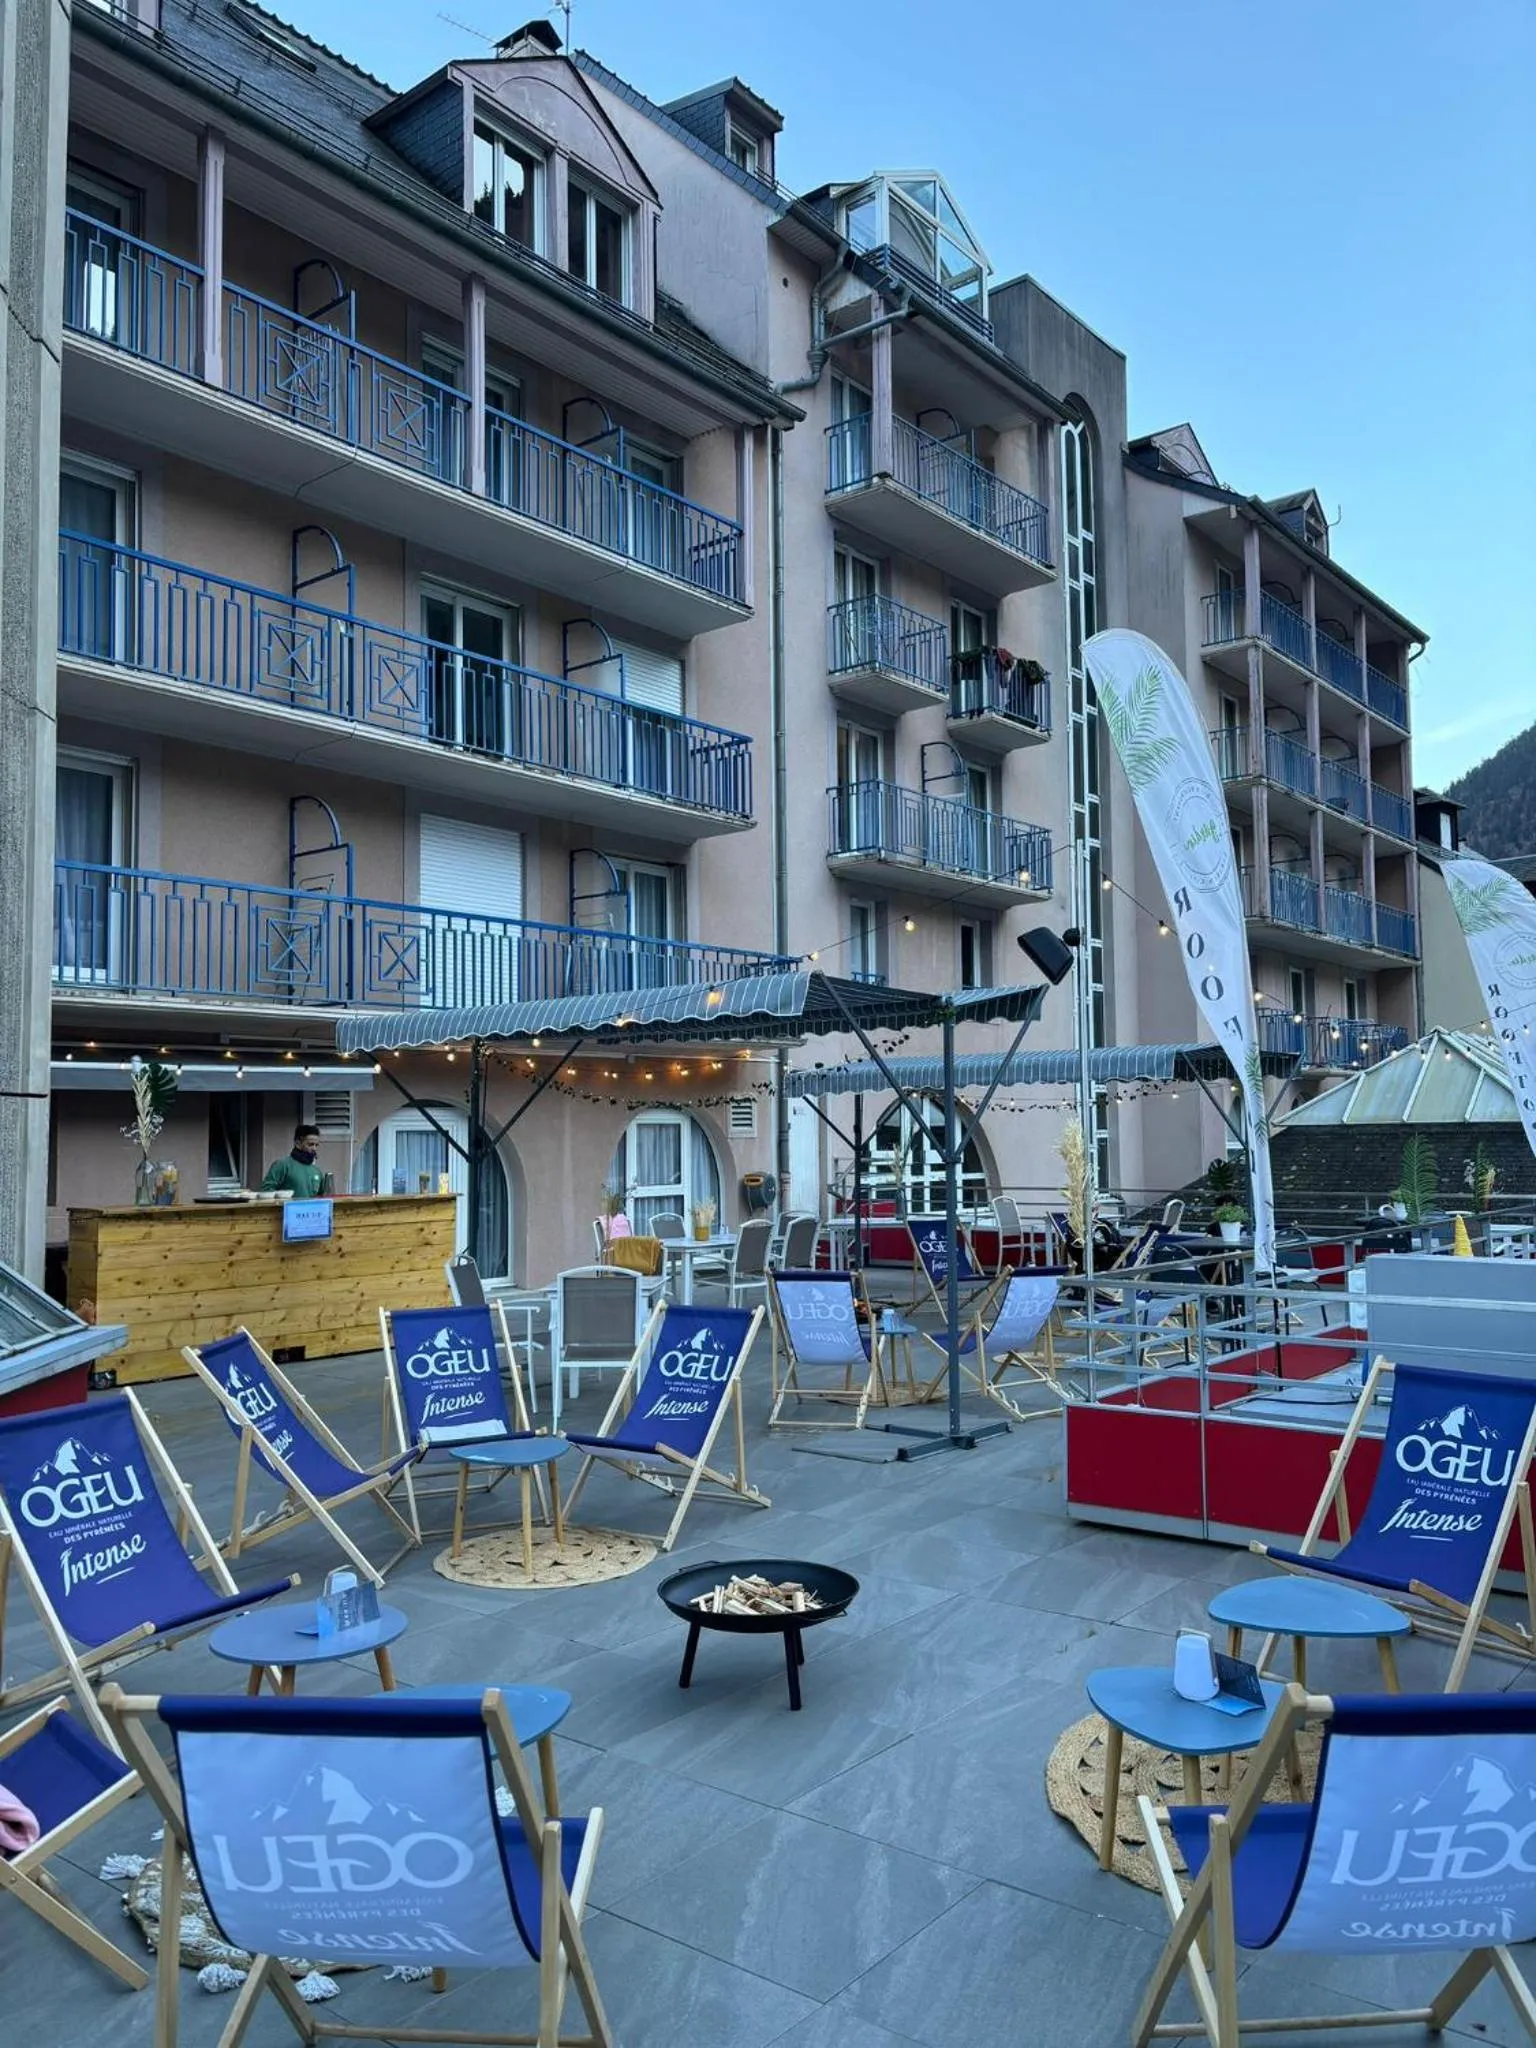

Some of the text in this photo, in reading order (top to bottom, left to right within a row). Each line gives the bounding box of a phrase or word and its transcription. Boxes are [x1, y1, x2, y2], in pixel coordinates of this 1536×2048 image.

[919, 1240, 950, 1253] OGE
[406, 1348, 491, 1379] OGEU
[659, 1350, 734, 1382] OGEU
[421, 1391, 486, 1425] Intense
[642, 1393, 710, 1420] Intense
[1396, 1434, 1515, 1487] OGEU
[20, 1465, 144, 1527] OGEU
[1415, 1487, 1432, 1497] DES
[1378, 1498, 1483, 1533] Intense
[63, 1533, 83, 1544] DES
[60, 1534, 147, 1597] Intense
